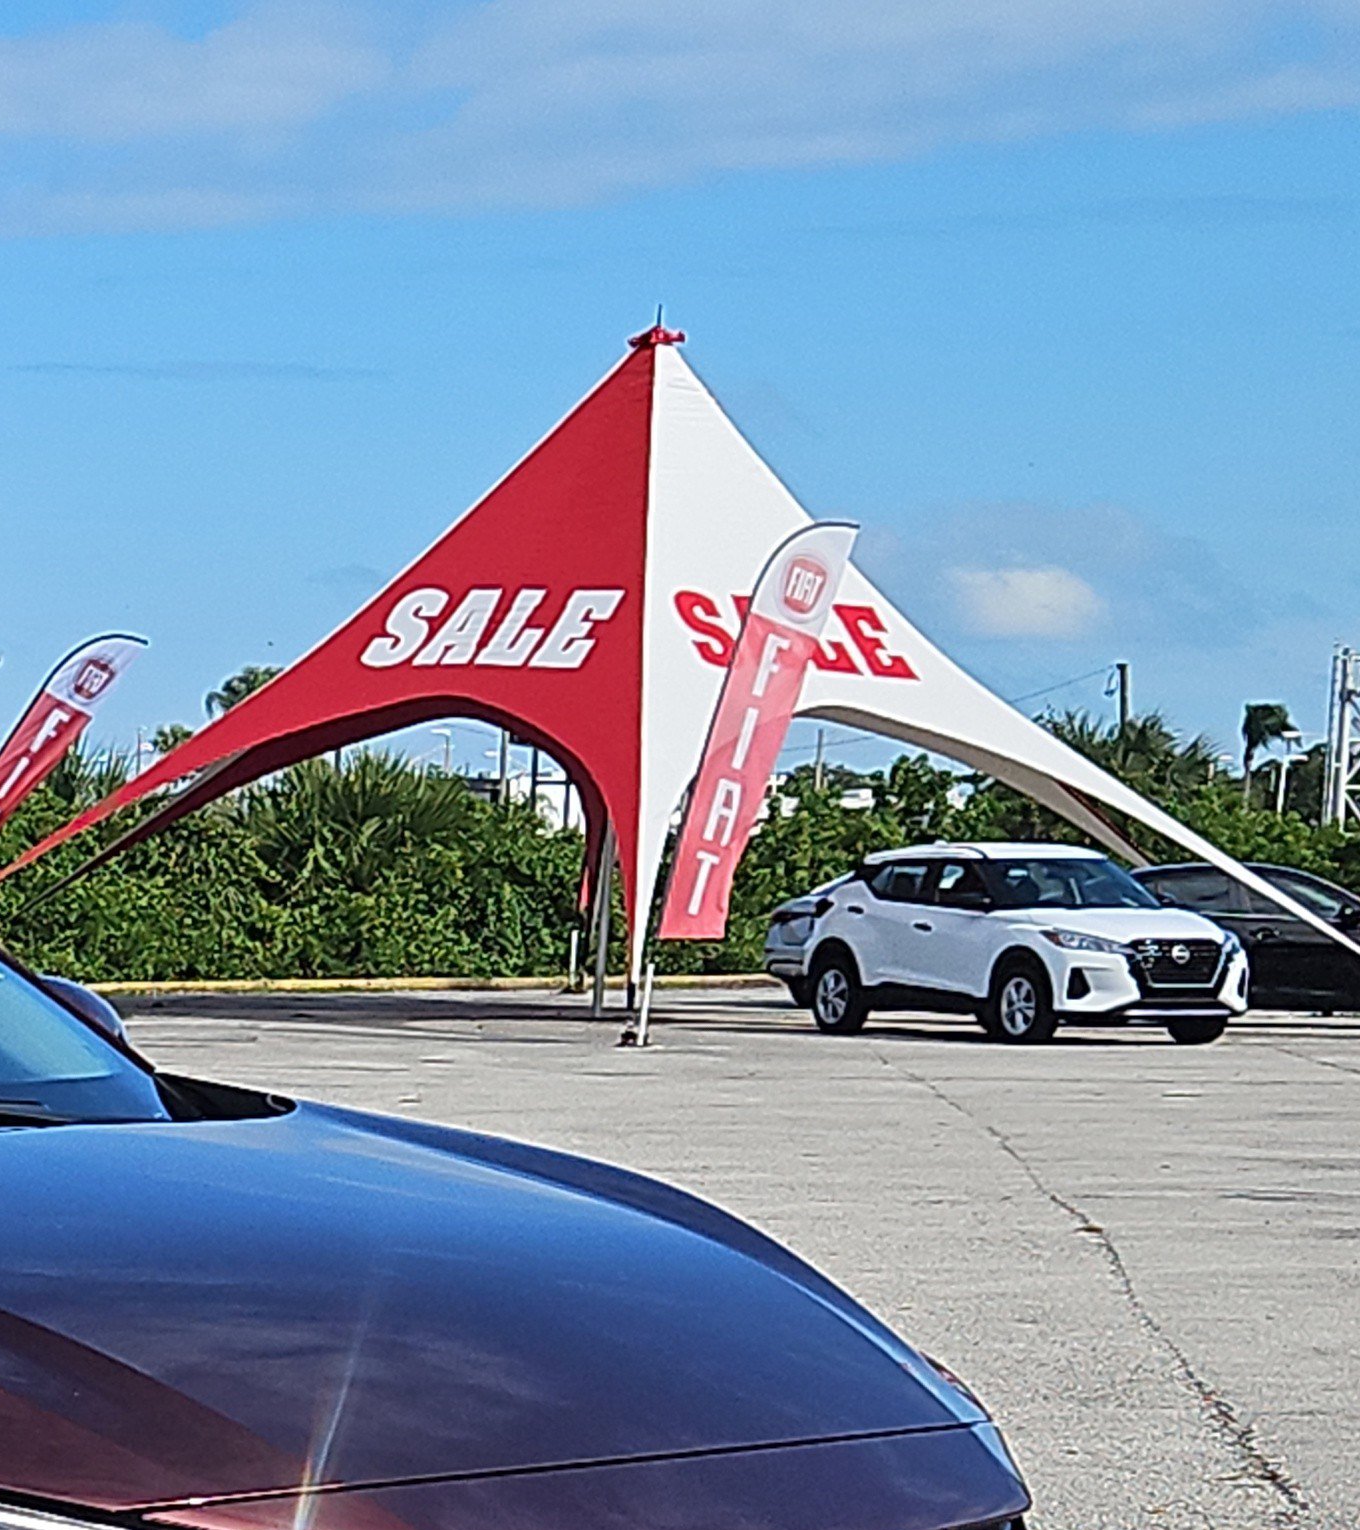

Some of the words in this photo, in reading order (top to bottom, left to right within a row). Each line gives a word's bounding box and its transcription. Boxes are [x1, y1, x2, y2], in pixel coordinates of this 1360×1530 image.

[360, 587, 626, 668] SALE
[785, 566, 826, 607] FIAT
[674, 589, 922, 681] SLE
[686, 632, 791, 916] FIAT
